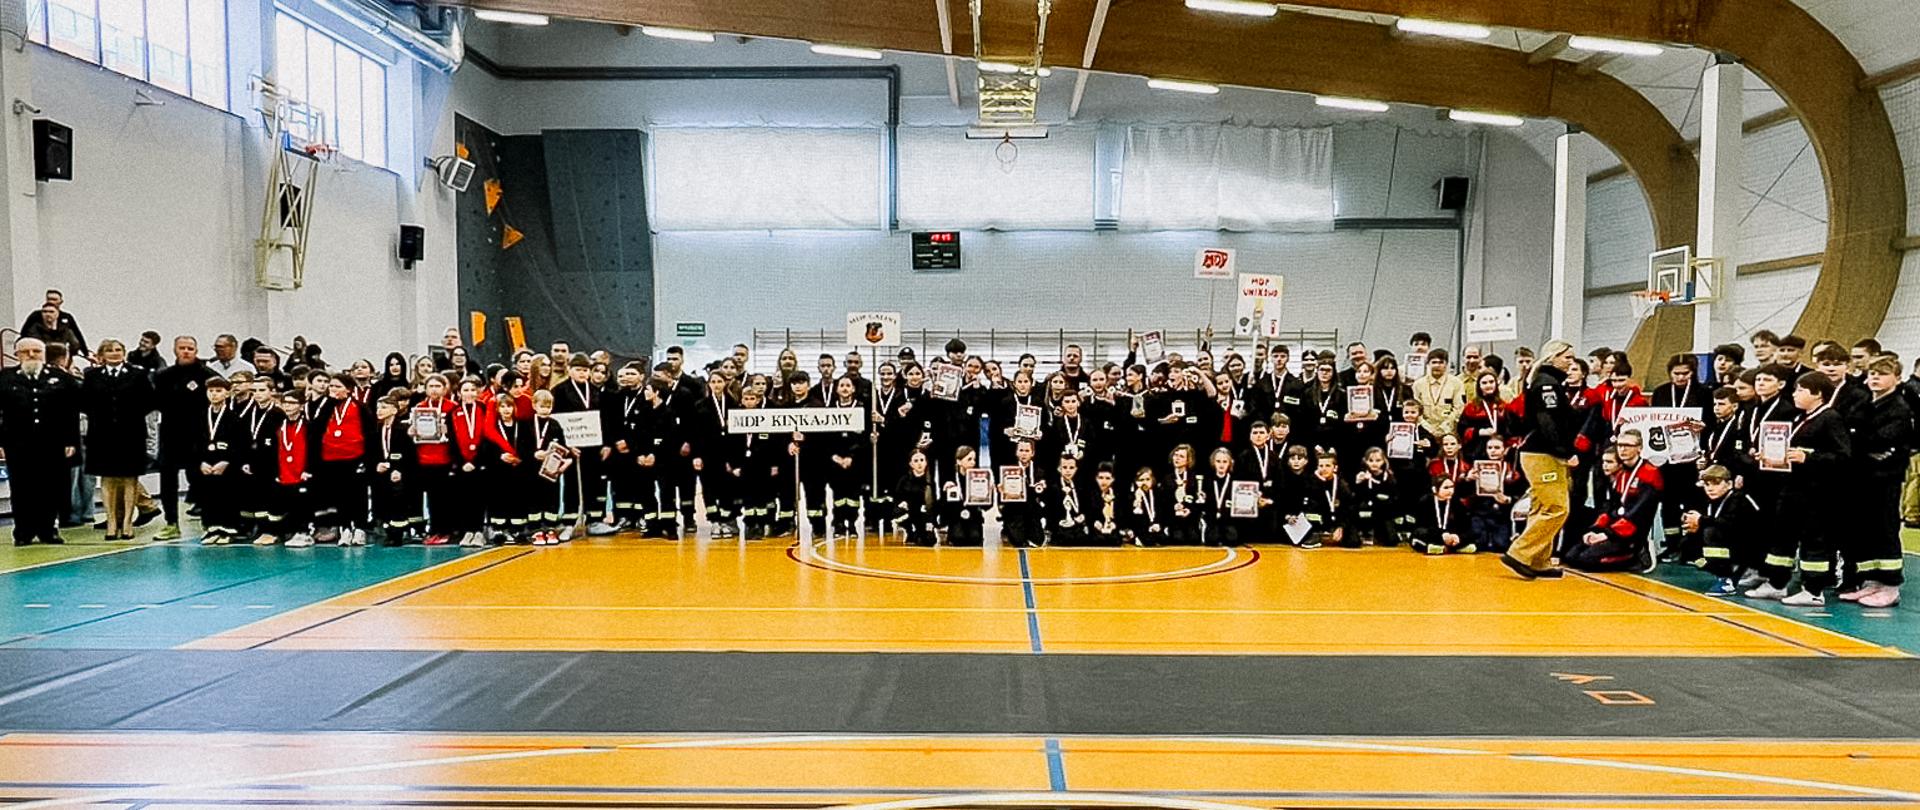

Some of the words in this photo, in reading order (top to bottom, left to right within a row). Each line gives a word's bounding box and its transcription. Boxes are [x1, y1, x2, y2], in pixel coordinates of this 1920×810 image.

[1251, 278, 1270, 286] MDP
[733, 415, 765, 428] MDP
[771, 413, 853, 427] KINKAJMY
